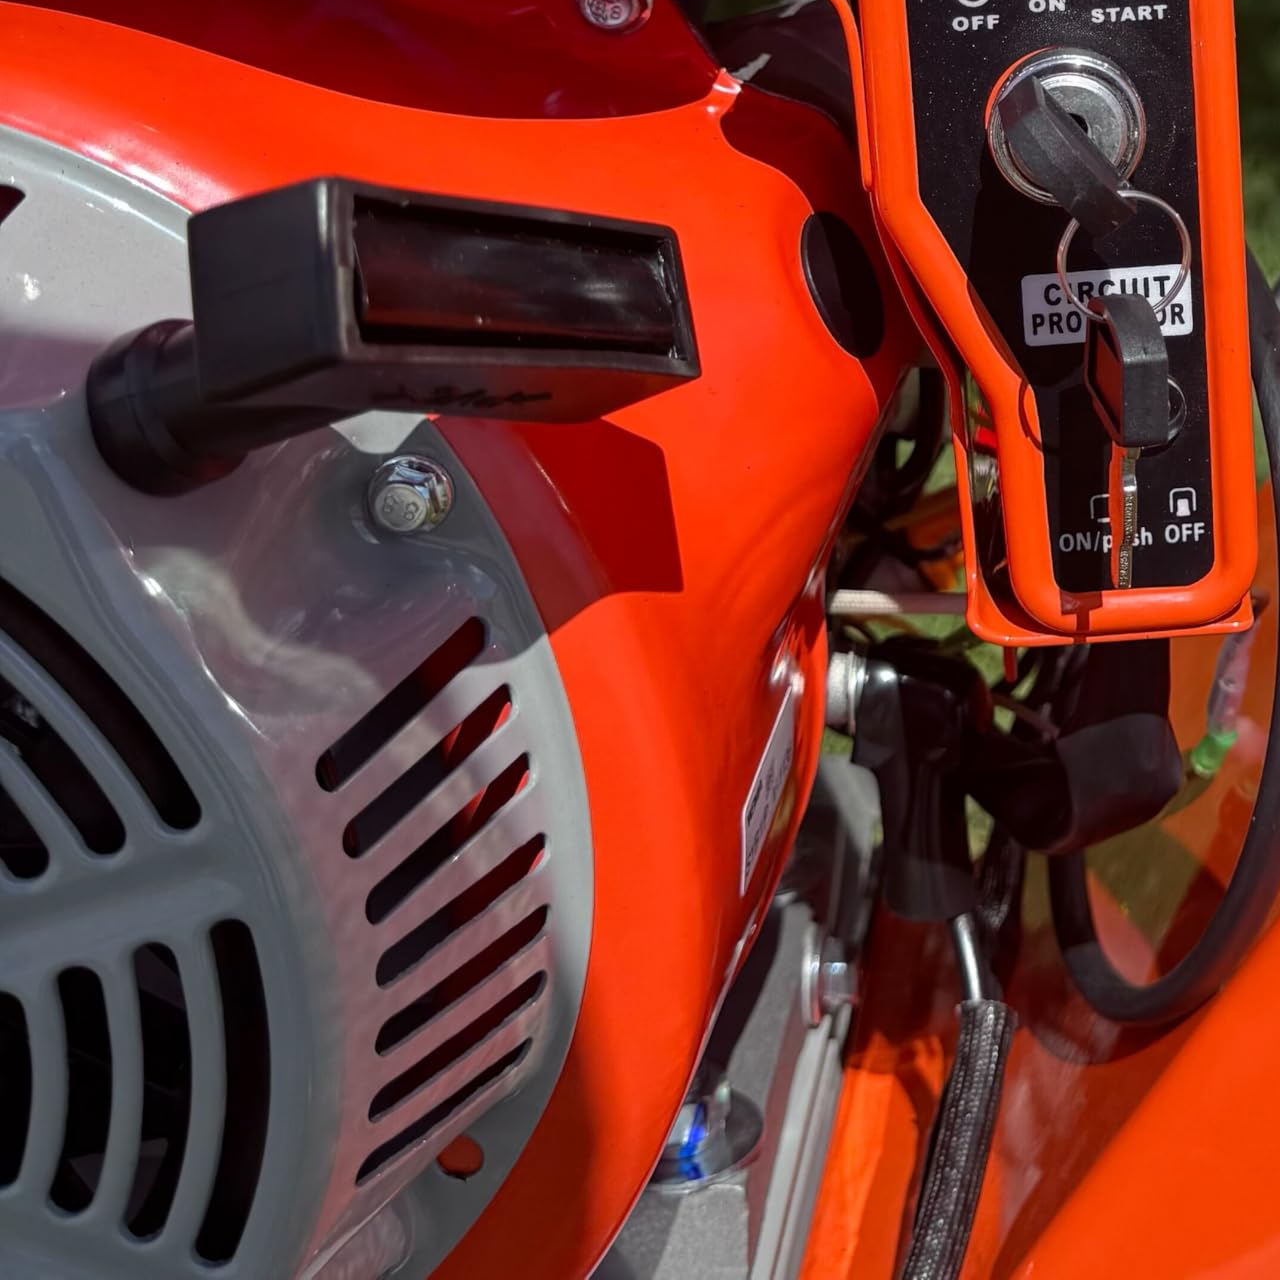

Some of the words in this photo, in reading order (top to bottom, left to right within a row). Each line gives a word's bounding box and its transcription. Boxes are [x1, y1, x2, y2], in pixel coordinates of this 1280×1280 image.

[952, 14, 1000, 32] OFF
[1091, 4, 1168, 24] START
[1164, 522, 1206, 544] OFF
